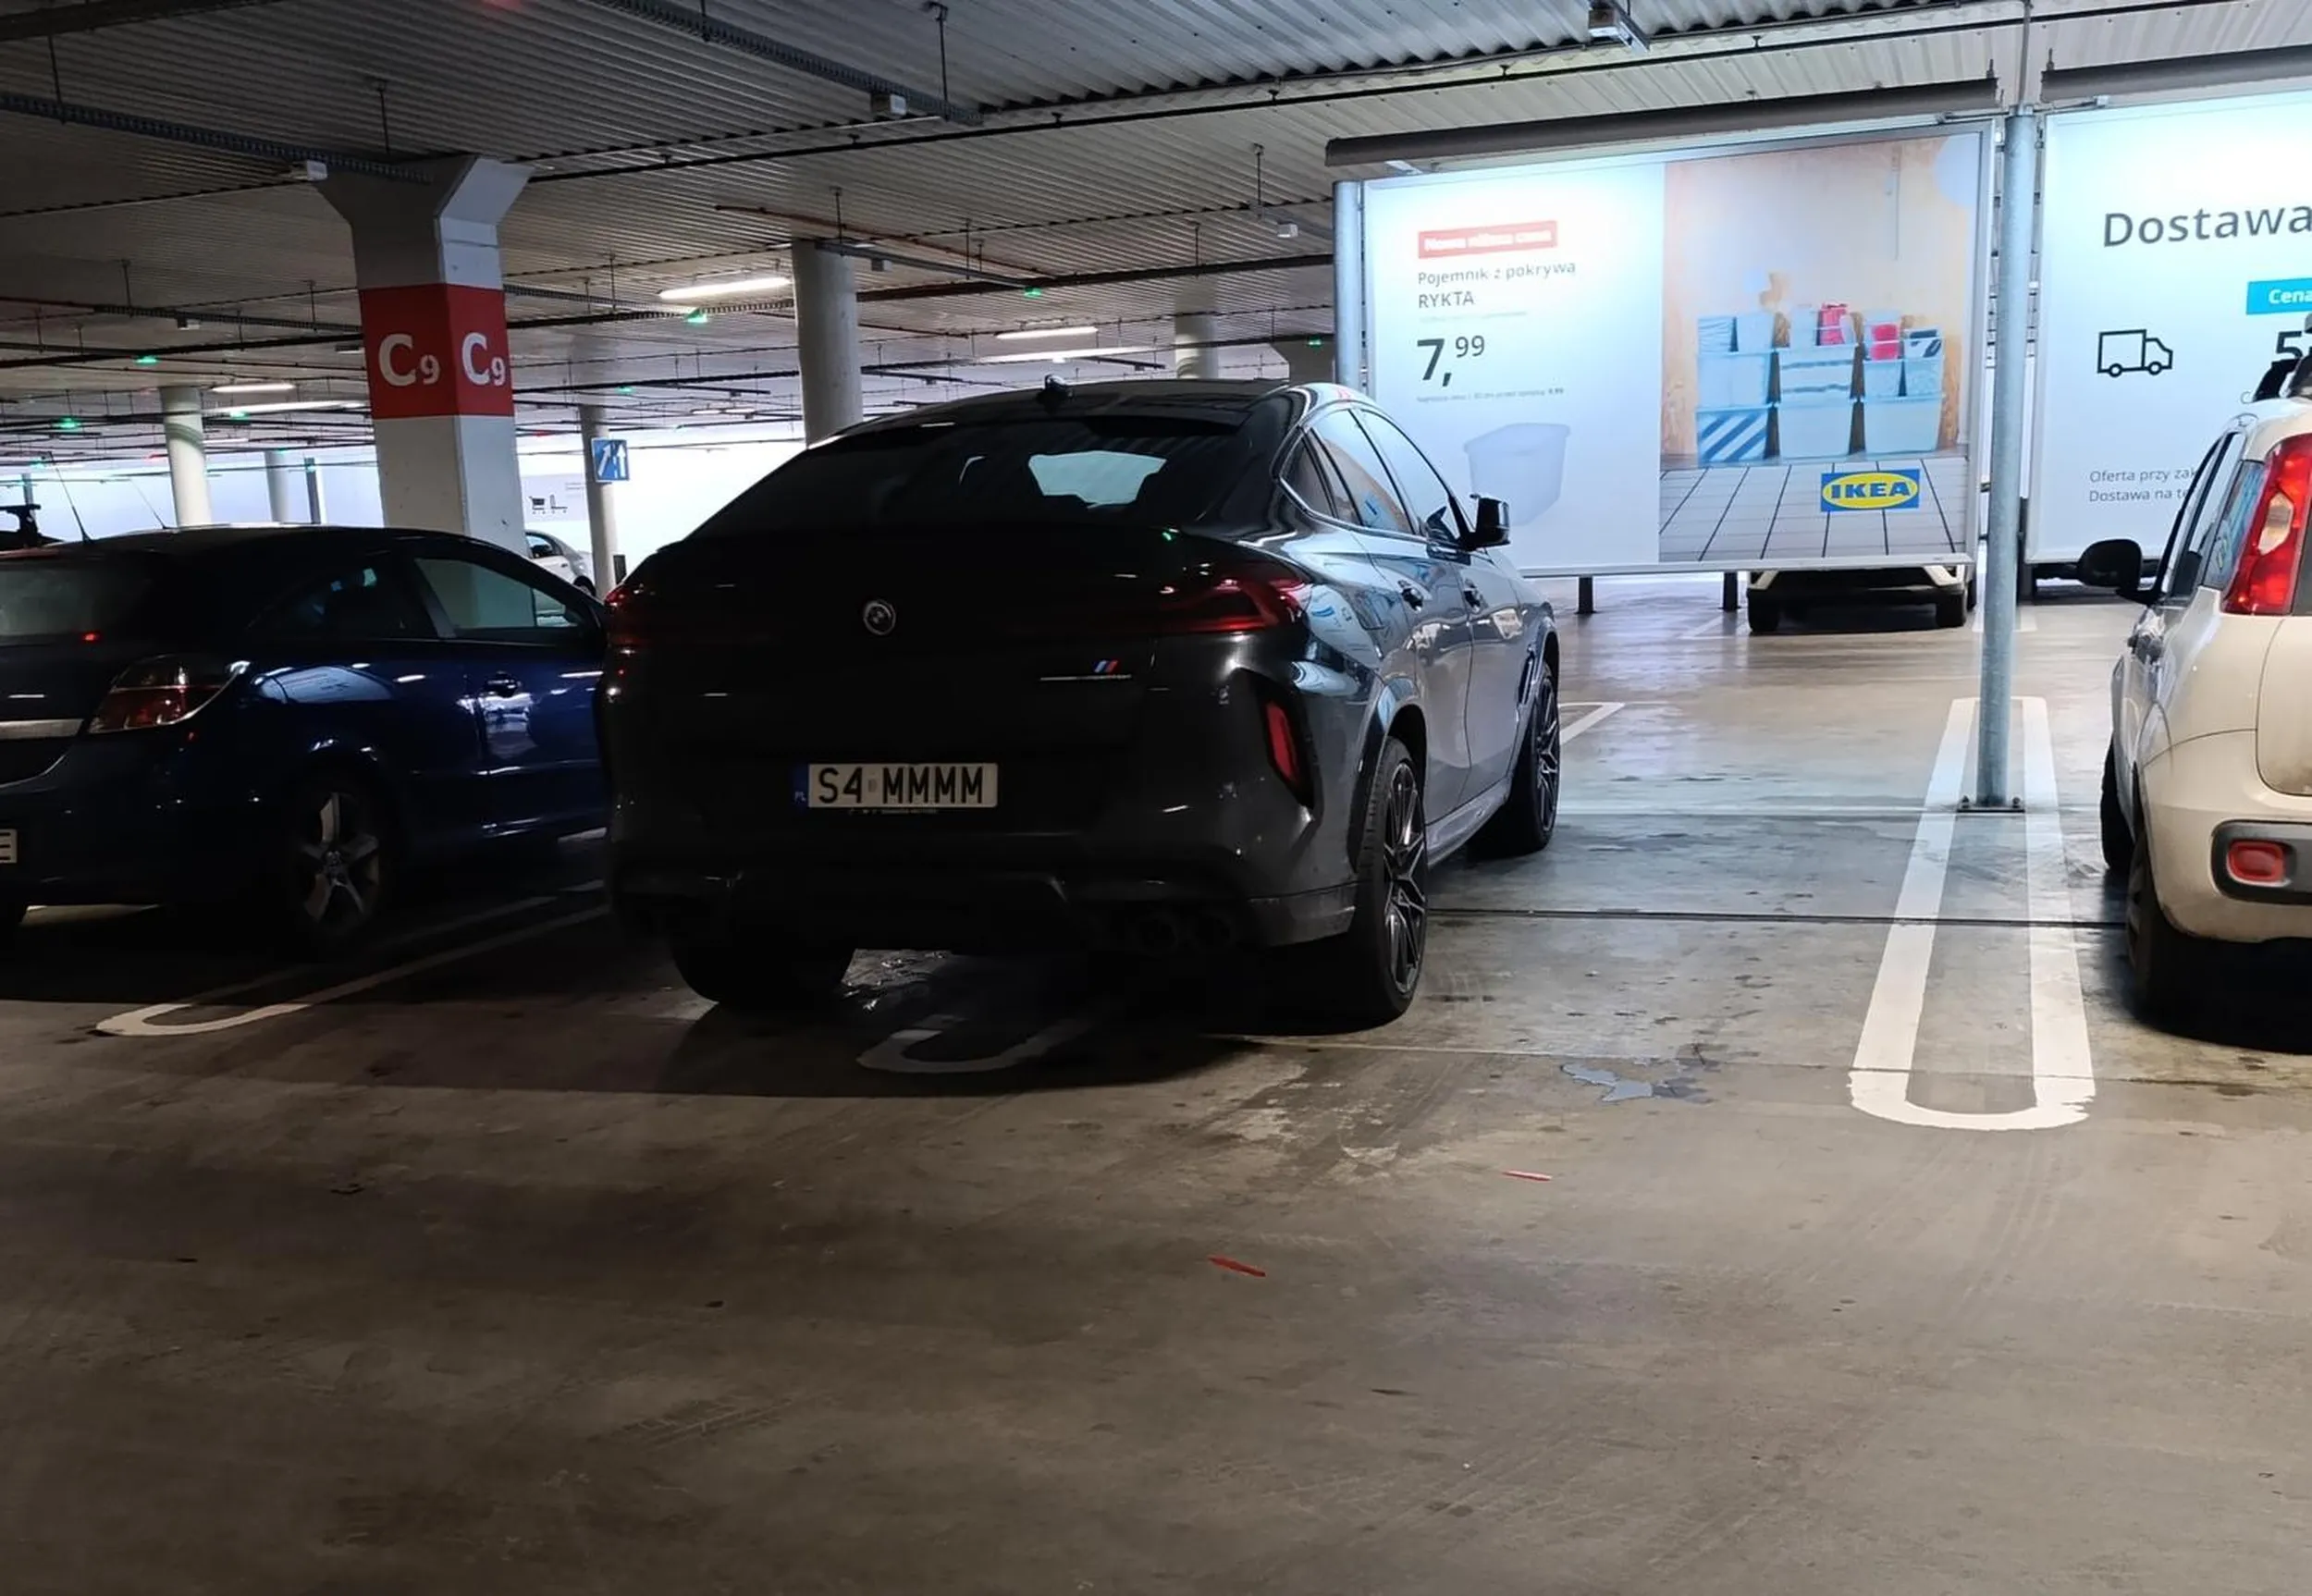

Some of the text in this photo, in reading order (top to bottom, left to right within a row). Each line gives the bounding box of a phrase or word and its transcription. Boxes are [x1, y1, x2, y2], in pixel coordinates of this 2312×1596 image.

[2104, 205, 2312, 248] Dostawa
[1418, 268, 1488, 288] Pojemnik
[1418, 291, 1475, 309] RYKTA
[377, 333, 440, 387] C9
[461, 332, 506, 387] C9
[2089, 470, 2135, 484] Oferta
[2139, 470, 2171, 484] przy
[1830, 481, 1911, 499] IKEA
[2089, 489, 2150, 502] Dostawa
[2155, 491, 2172, 500] na
[818, 766, 983, 804] S4 MMMM
